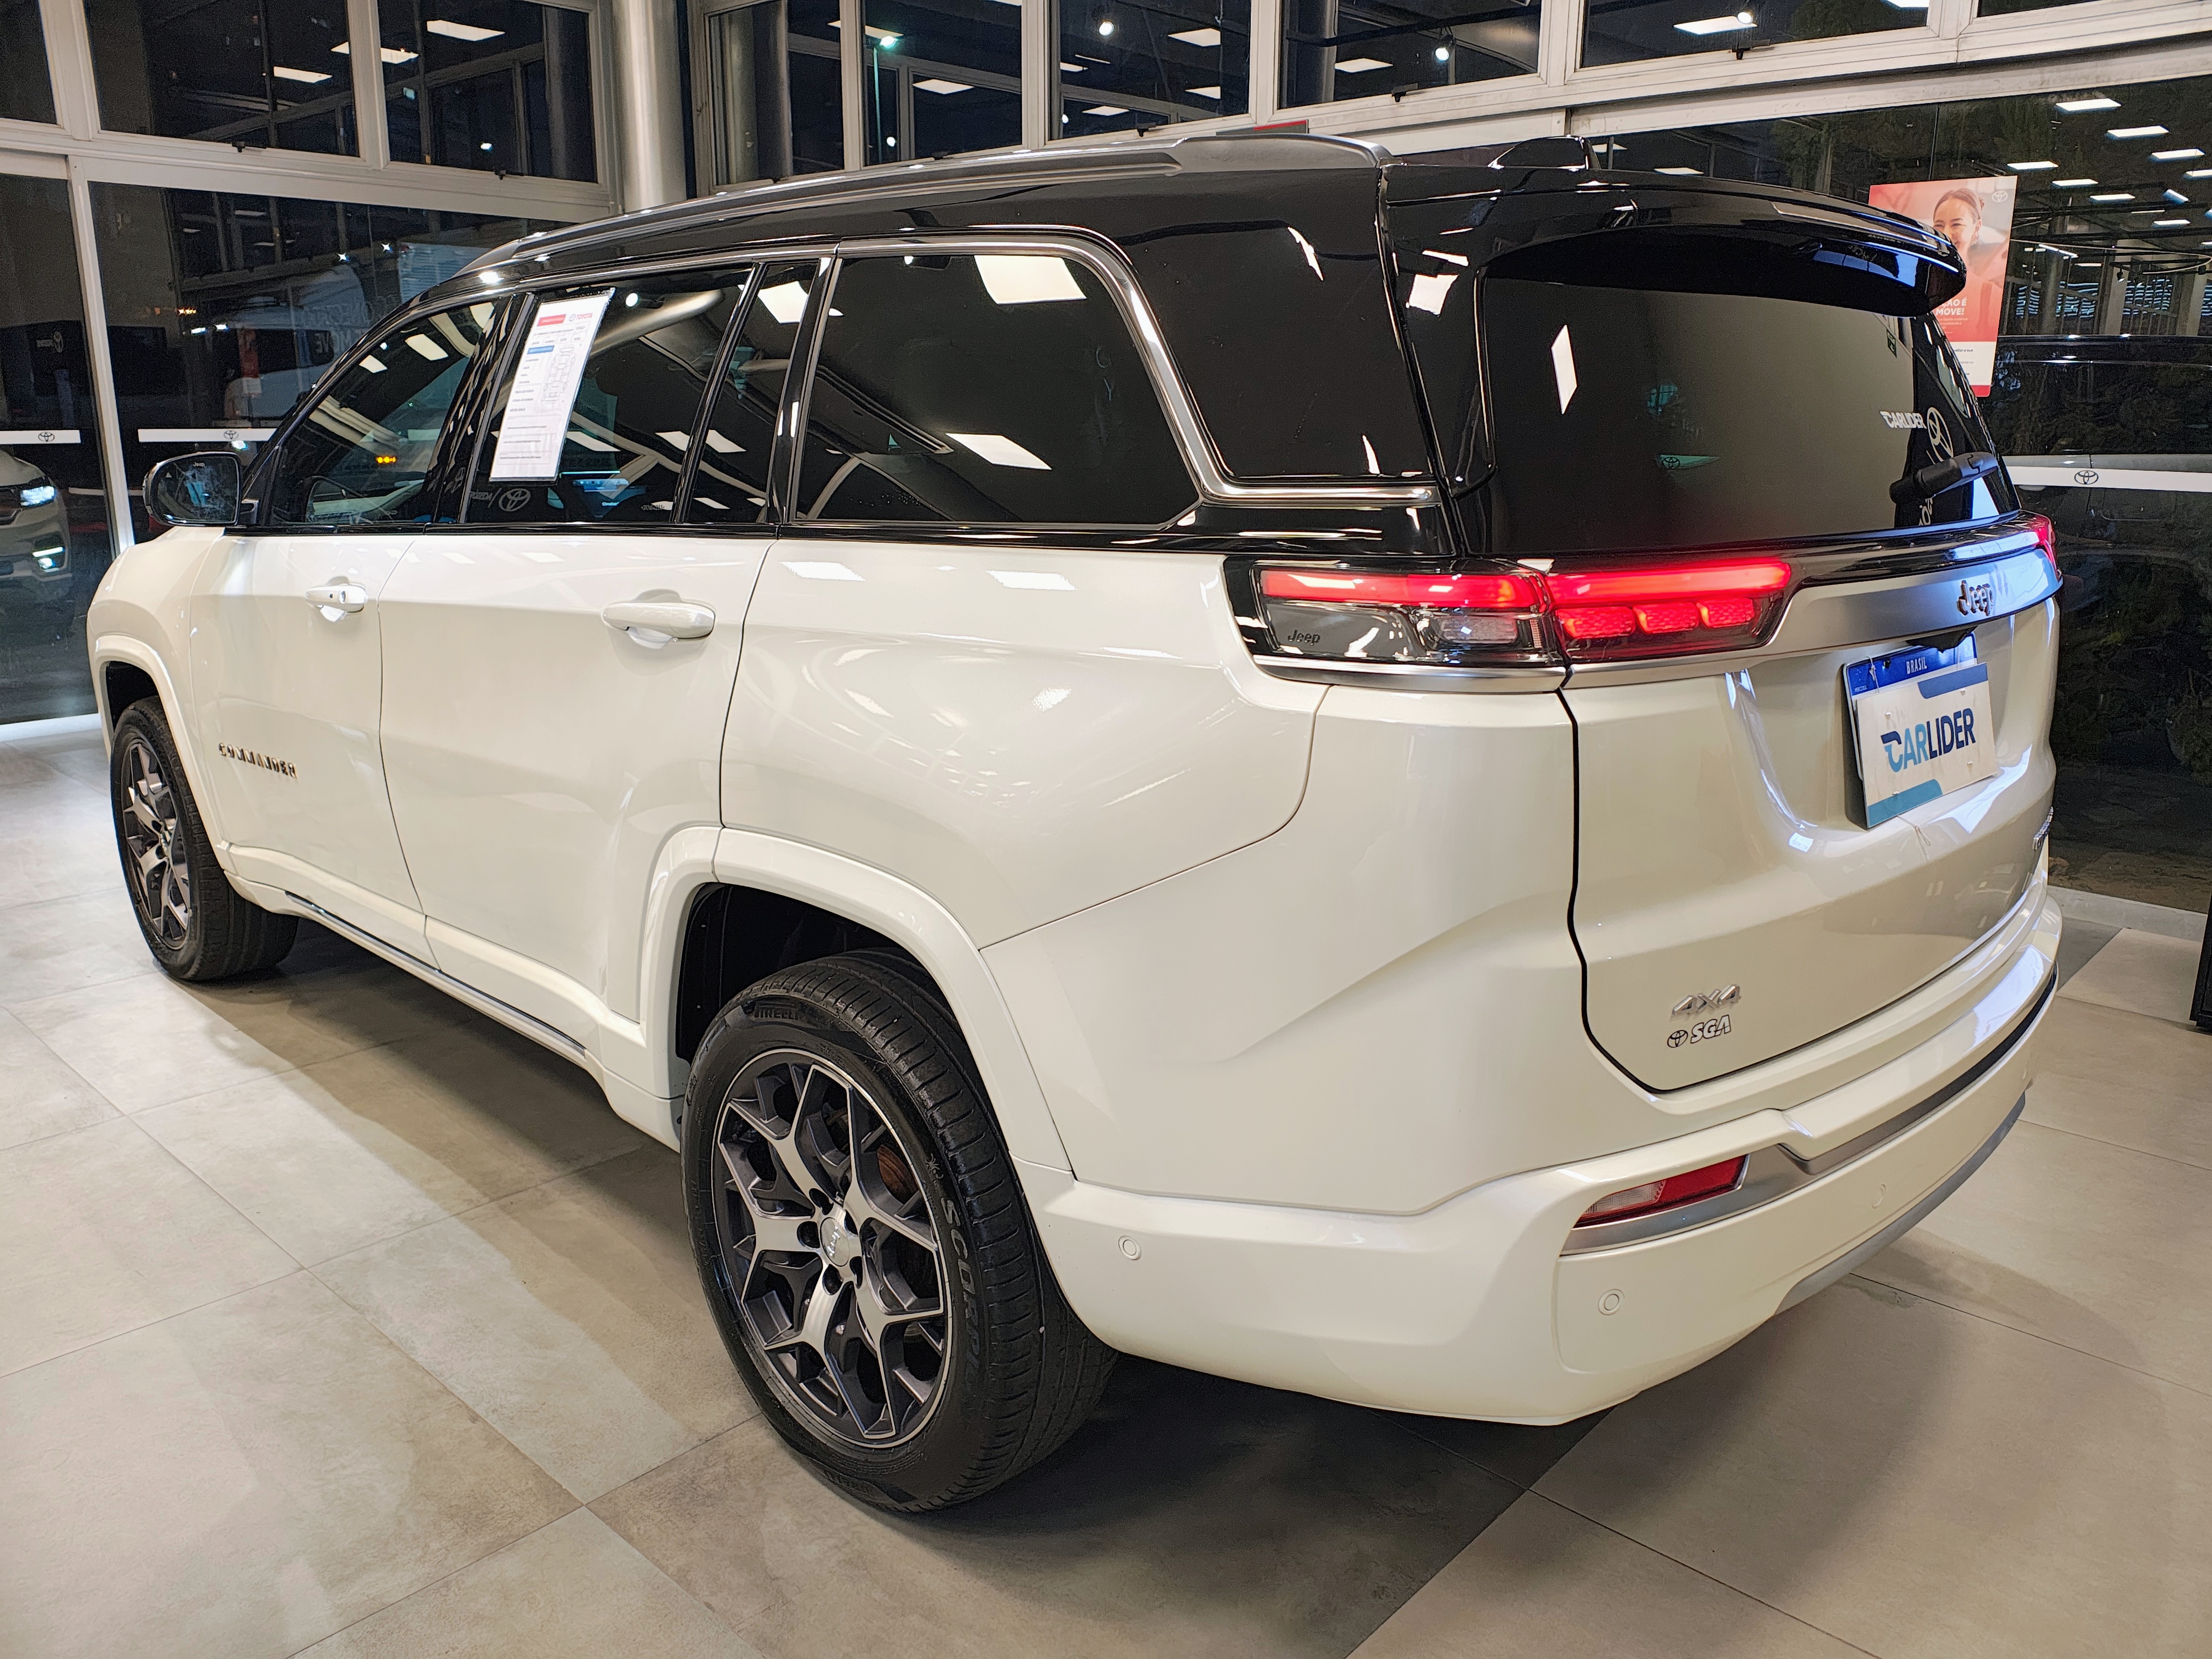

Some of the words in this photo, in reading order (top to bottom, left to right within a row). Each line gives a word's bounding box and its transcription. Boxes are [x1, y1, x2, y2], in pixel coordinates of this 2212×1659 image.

[1936, 307, 1965, 316] MOVE!
[1879, 410, 1927, 429] CARLIDER
[1957, 579, 1995, 617] Jeep
[1287, 629, 1321, 646] Jeep
[1905, 656, 1927, 675] BRASIL
[1880, 707, 1977, 773] CARLIDER
[1690, 1014, 1732, 1044] SGA
